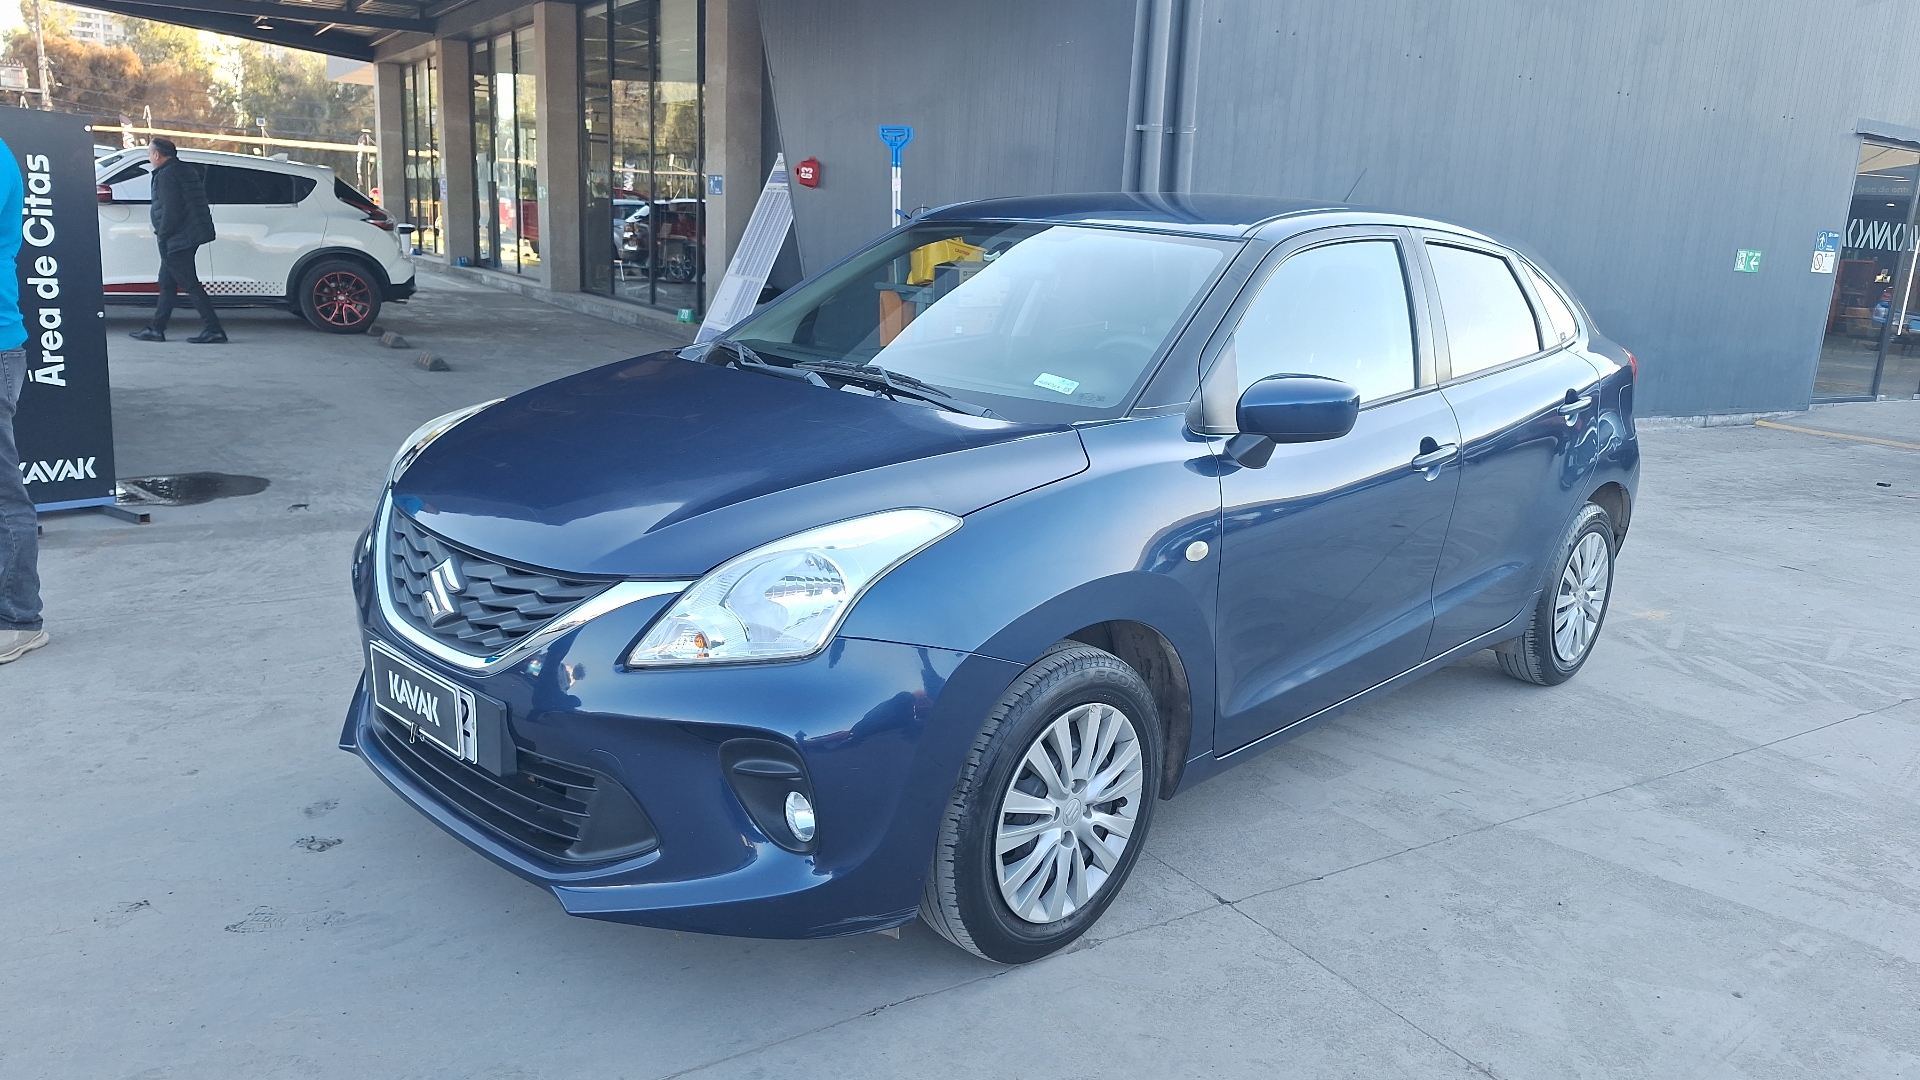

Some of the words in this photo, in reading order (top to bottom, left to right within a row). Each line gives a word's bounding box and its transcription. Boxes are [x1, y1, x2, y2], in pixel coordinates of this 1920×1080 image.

[23, 153, 55, 247] Citas
[27, 256, 59, 300] de
[681, 309, 689, 319] 20
[28, 308, 66, 387] Área
[388, 670, 440, 727] KAVAK
